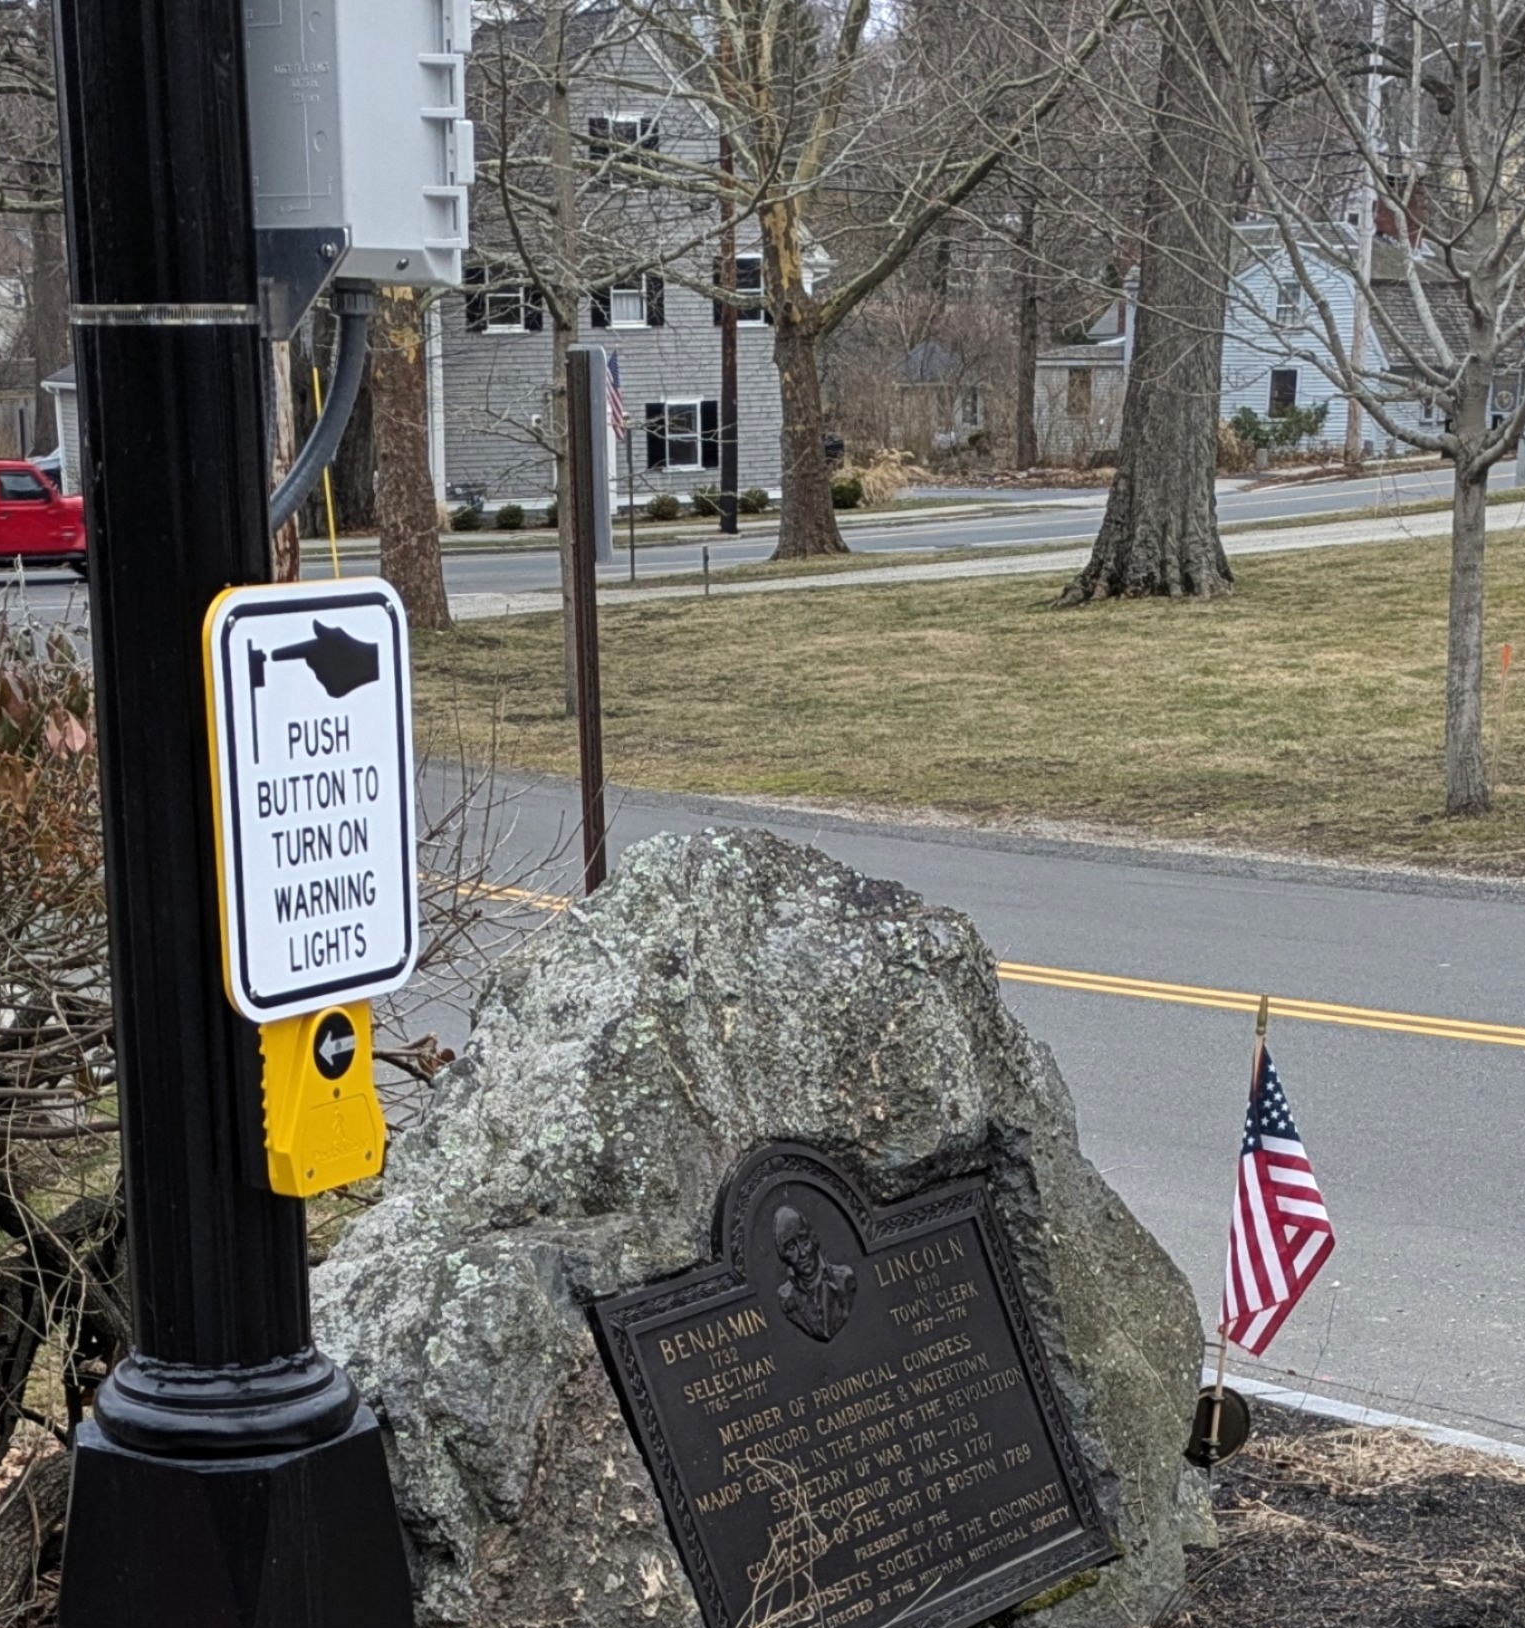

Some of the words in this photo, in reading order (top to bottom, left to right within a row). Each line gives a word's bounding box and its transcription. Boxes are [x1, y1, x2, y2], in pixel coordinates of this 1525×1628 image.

[287, 715, 351, 760] PUSH
[257, 769, 346, 819] BUTTON
[352, 765, 379, 803] TO
[271, 827, 334, 869] TURN
[338, 817, 368, 857] ON
[275, 869, 377, 924] WARNING
[289, 923, 368, 972] LIGHTS
[659, 1306, 768, 1365] BENJAMIN
[874, 1235, 964, 1287] LINCOLN
[889, 1296, 931, 1325] TOWN
[936, 1280, 979, 1309] CLERK
[914, 1272, 940, 1293] 1810
[683, 1355, 776, 1404] SELECTMAN
[708, 1346, 739, 1369] 1732
[719, 1407, 784, 1446] MEMBER
[789, 1397, 807, 1418] OF
[812, 1362, 897, 1408] PROVINCIAL
[902, 1333, 972, 1372] CONGRESS
[722, 1452, 740, 1475] AT
[745, 1425, 810, 1464] CONCORD
[816, 1391, 895, 1435] CAMBRIDGE
[896, 1384, 909, 1402] &
[909, 1352, 990, 1397] WATERTOWN
[695, 1482, 742, 1515] MAJOR
[811, 1449, 825, 1467] IN
[827, 1435, 857, 1460] THE
[860, 1418, 896, 1448] ARMY
[899, 1410, 914, 1430] OF
[917, 1398, 945, 1419] THE
[946, 1366, 1025, 1411] REVOLUTION
[855, 1457, 871, 1477] OF
[873, 1444, 906, 1466] WAR
[898, 1466, 914, 1487] OF
[964, 1432, 992, 1458] 1787
[833, 1522, 850, 1543] OF
[853, 1508, 885, 1536] THE
[888, 1490, 922, 1520] PORT
[926, 1482, 942, 1502] OF
[946, 1458, 999, 1494] BOSTON
[1002, 1443, 1033, 1469] 1789
[854, 1528, 908, 1562] PRESIDENT
[913, 1520, 925, 1536] OF
[928, 1510, 950, 1528] THE
[876, 1540, 935, 1580] SOCIETY
[938, 1531, 953, 1552] OF
[956, 1516, 986, 1542] THE
[989, 1482, 1062, 1528] CINCINNATI
[879, 1589, 892, 1605] BY
[893, 1579, 916, 1596] THE
[969, 1526, 1028, 1562] HISTORICAL
[1030, 1505, 1071, 1534] SOCIETY
